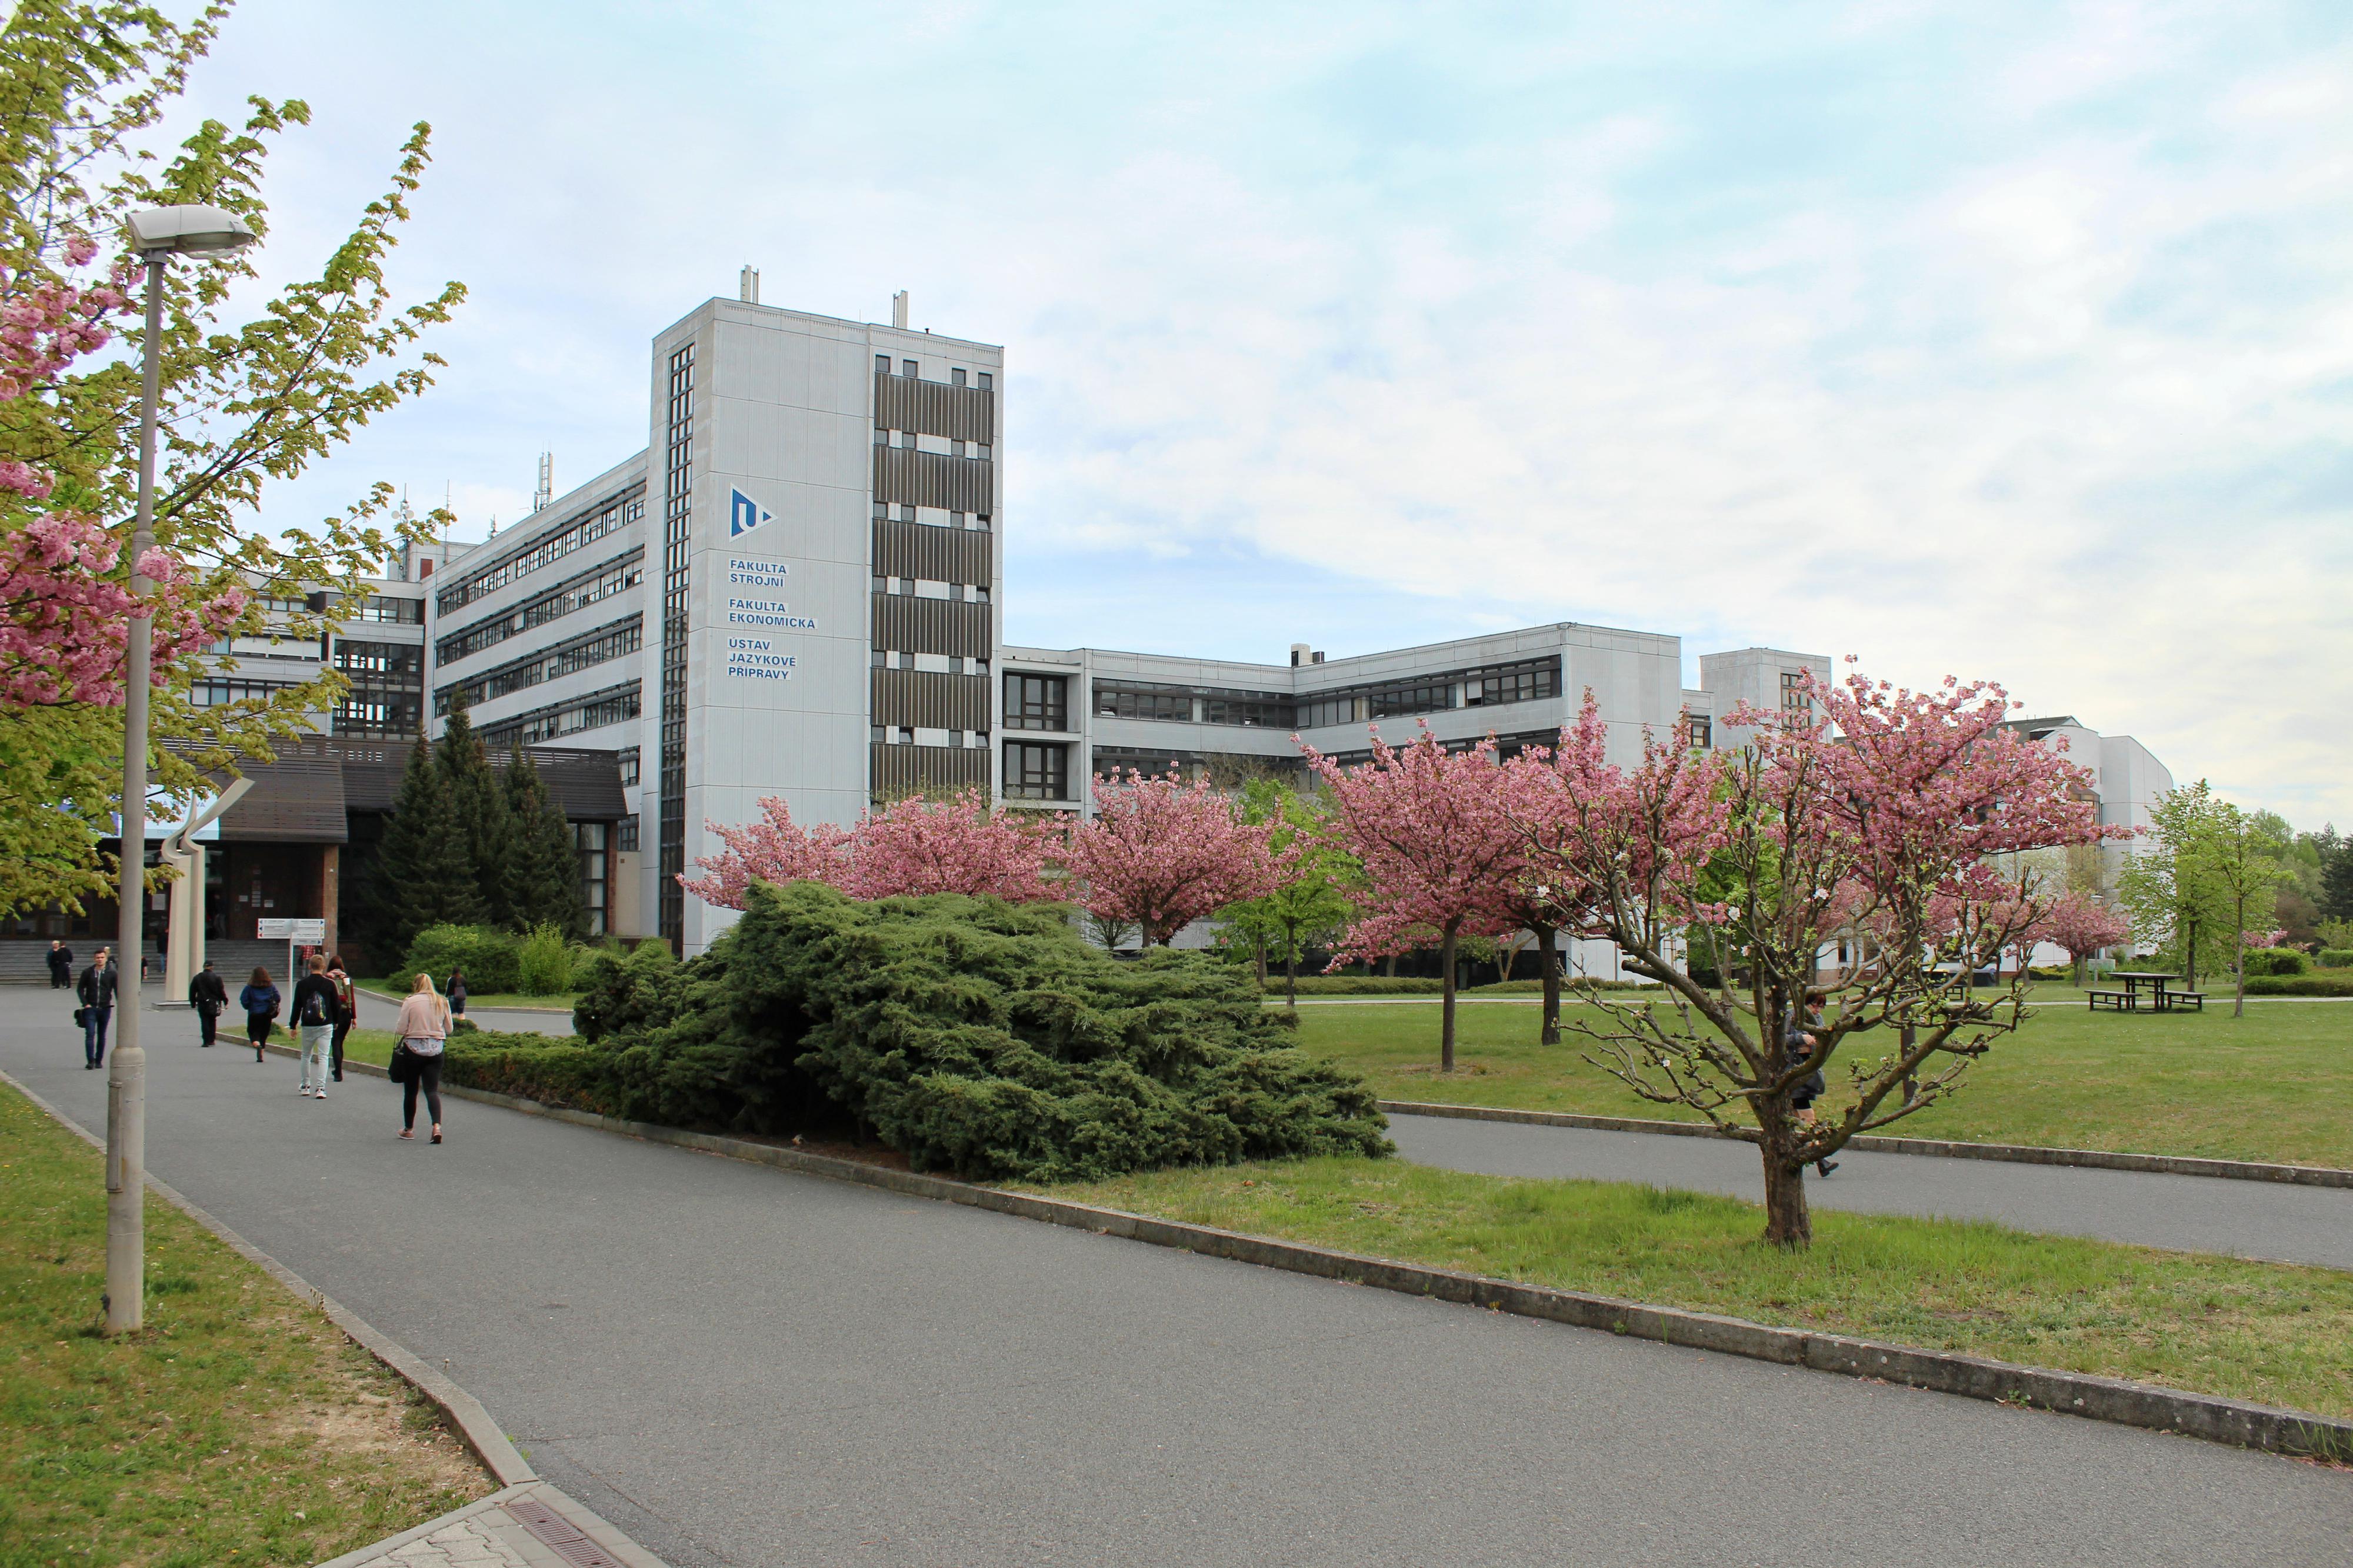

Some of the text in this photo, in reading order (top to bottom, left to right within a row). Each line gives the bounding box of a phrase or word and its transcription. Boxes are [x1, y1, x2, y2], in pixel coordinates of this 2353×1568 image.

[730, 560, 787, 574] FAKULTA
[730, 573, 784, 587] STROJNÍ
[729, 599, 786, 612] FAKULTA
[729, 612, 815, 629] EKONOMICKÁ
[729, 637, 771, 650] ÚSTAV
[729, 652, 796, 666] JAZYKOVÉ
[728, 665, 789, 679] PŘÍPRAVY
